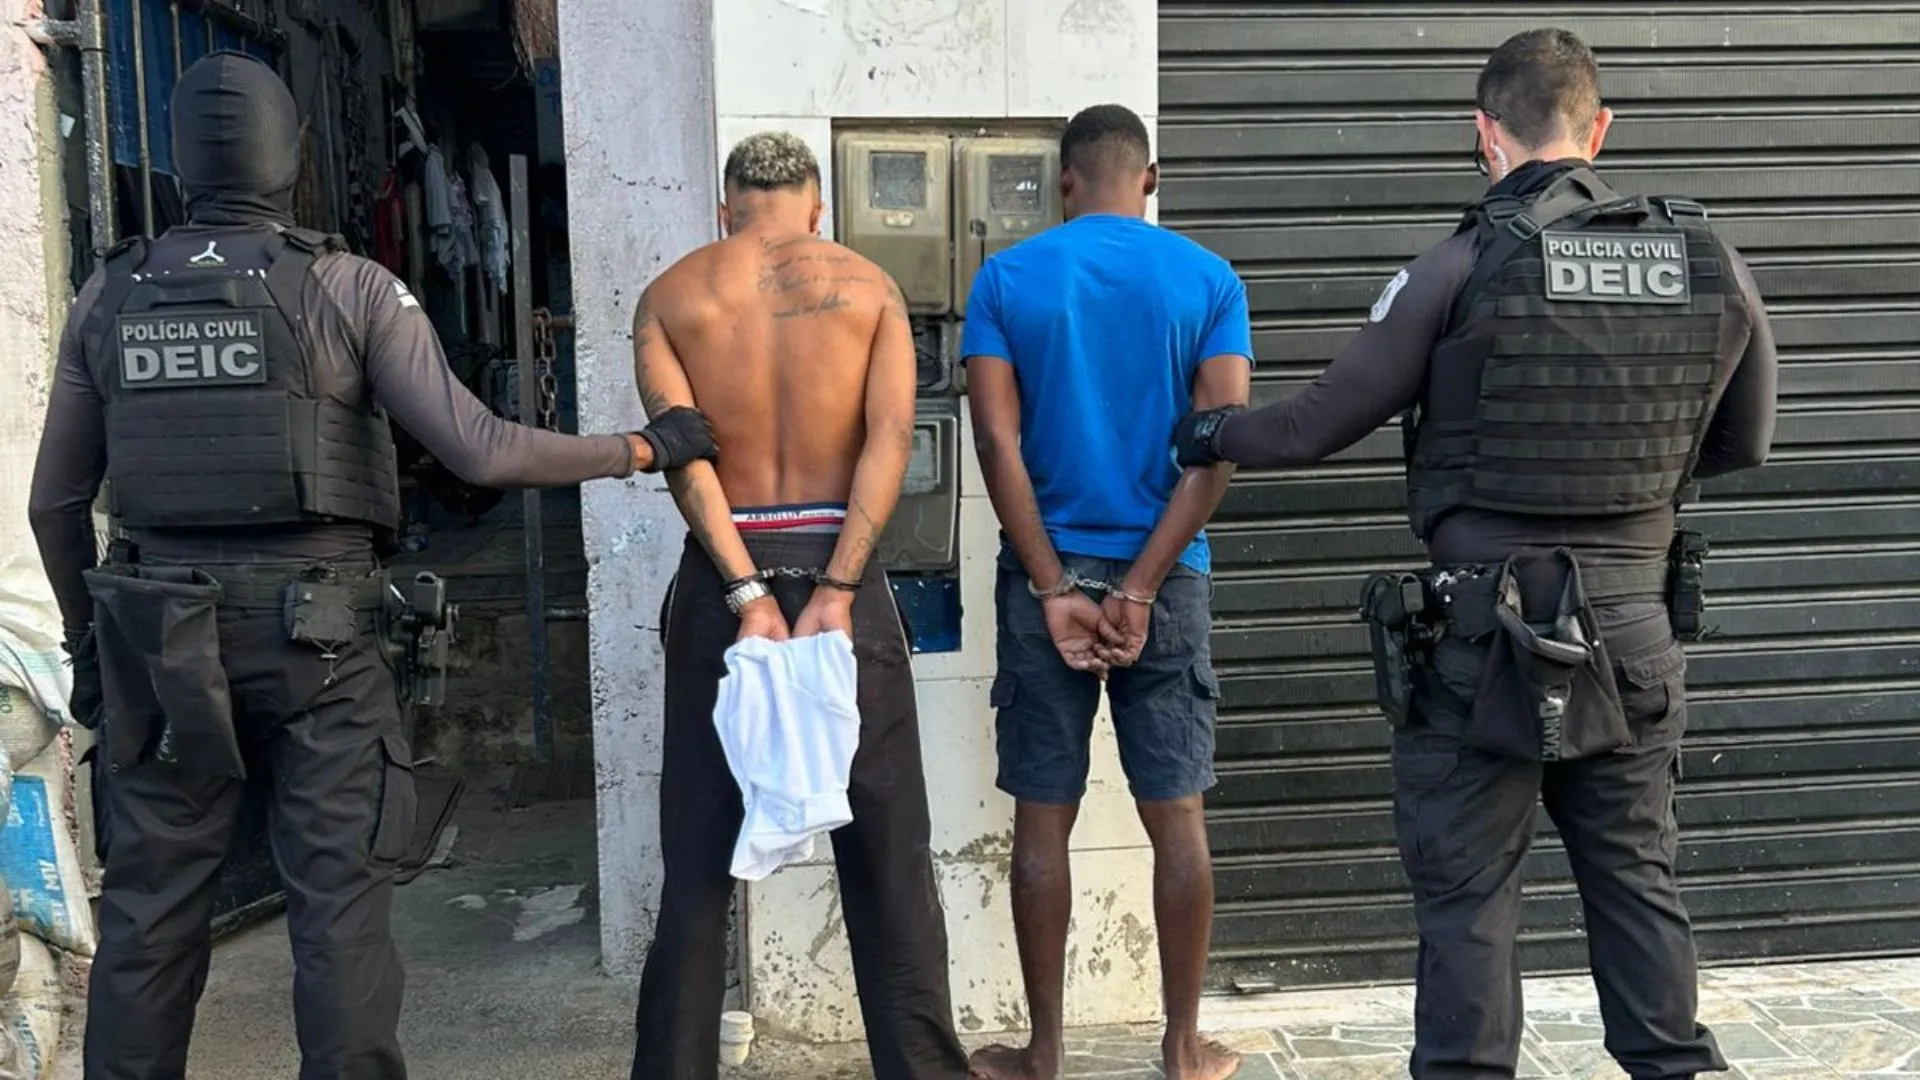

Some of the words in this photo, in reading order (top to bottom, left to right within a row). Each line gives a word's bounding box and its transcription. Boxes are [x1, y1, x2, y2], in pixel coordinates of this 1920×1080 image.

[1550, 238, 1625, 257] POLÍCIA
[1630, 243, 1682, 258] CIVIL
[1551, 261, 1684, 296] DEIC
[122, 320, 199, 341] POLÍCIA
[204, 320, 257, 338] CIVIL
[124, 343, 259, 380] DEIC
